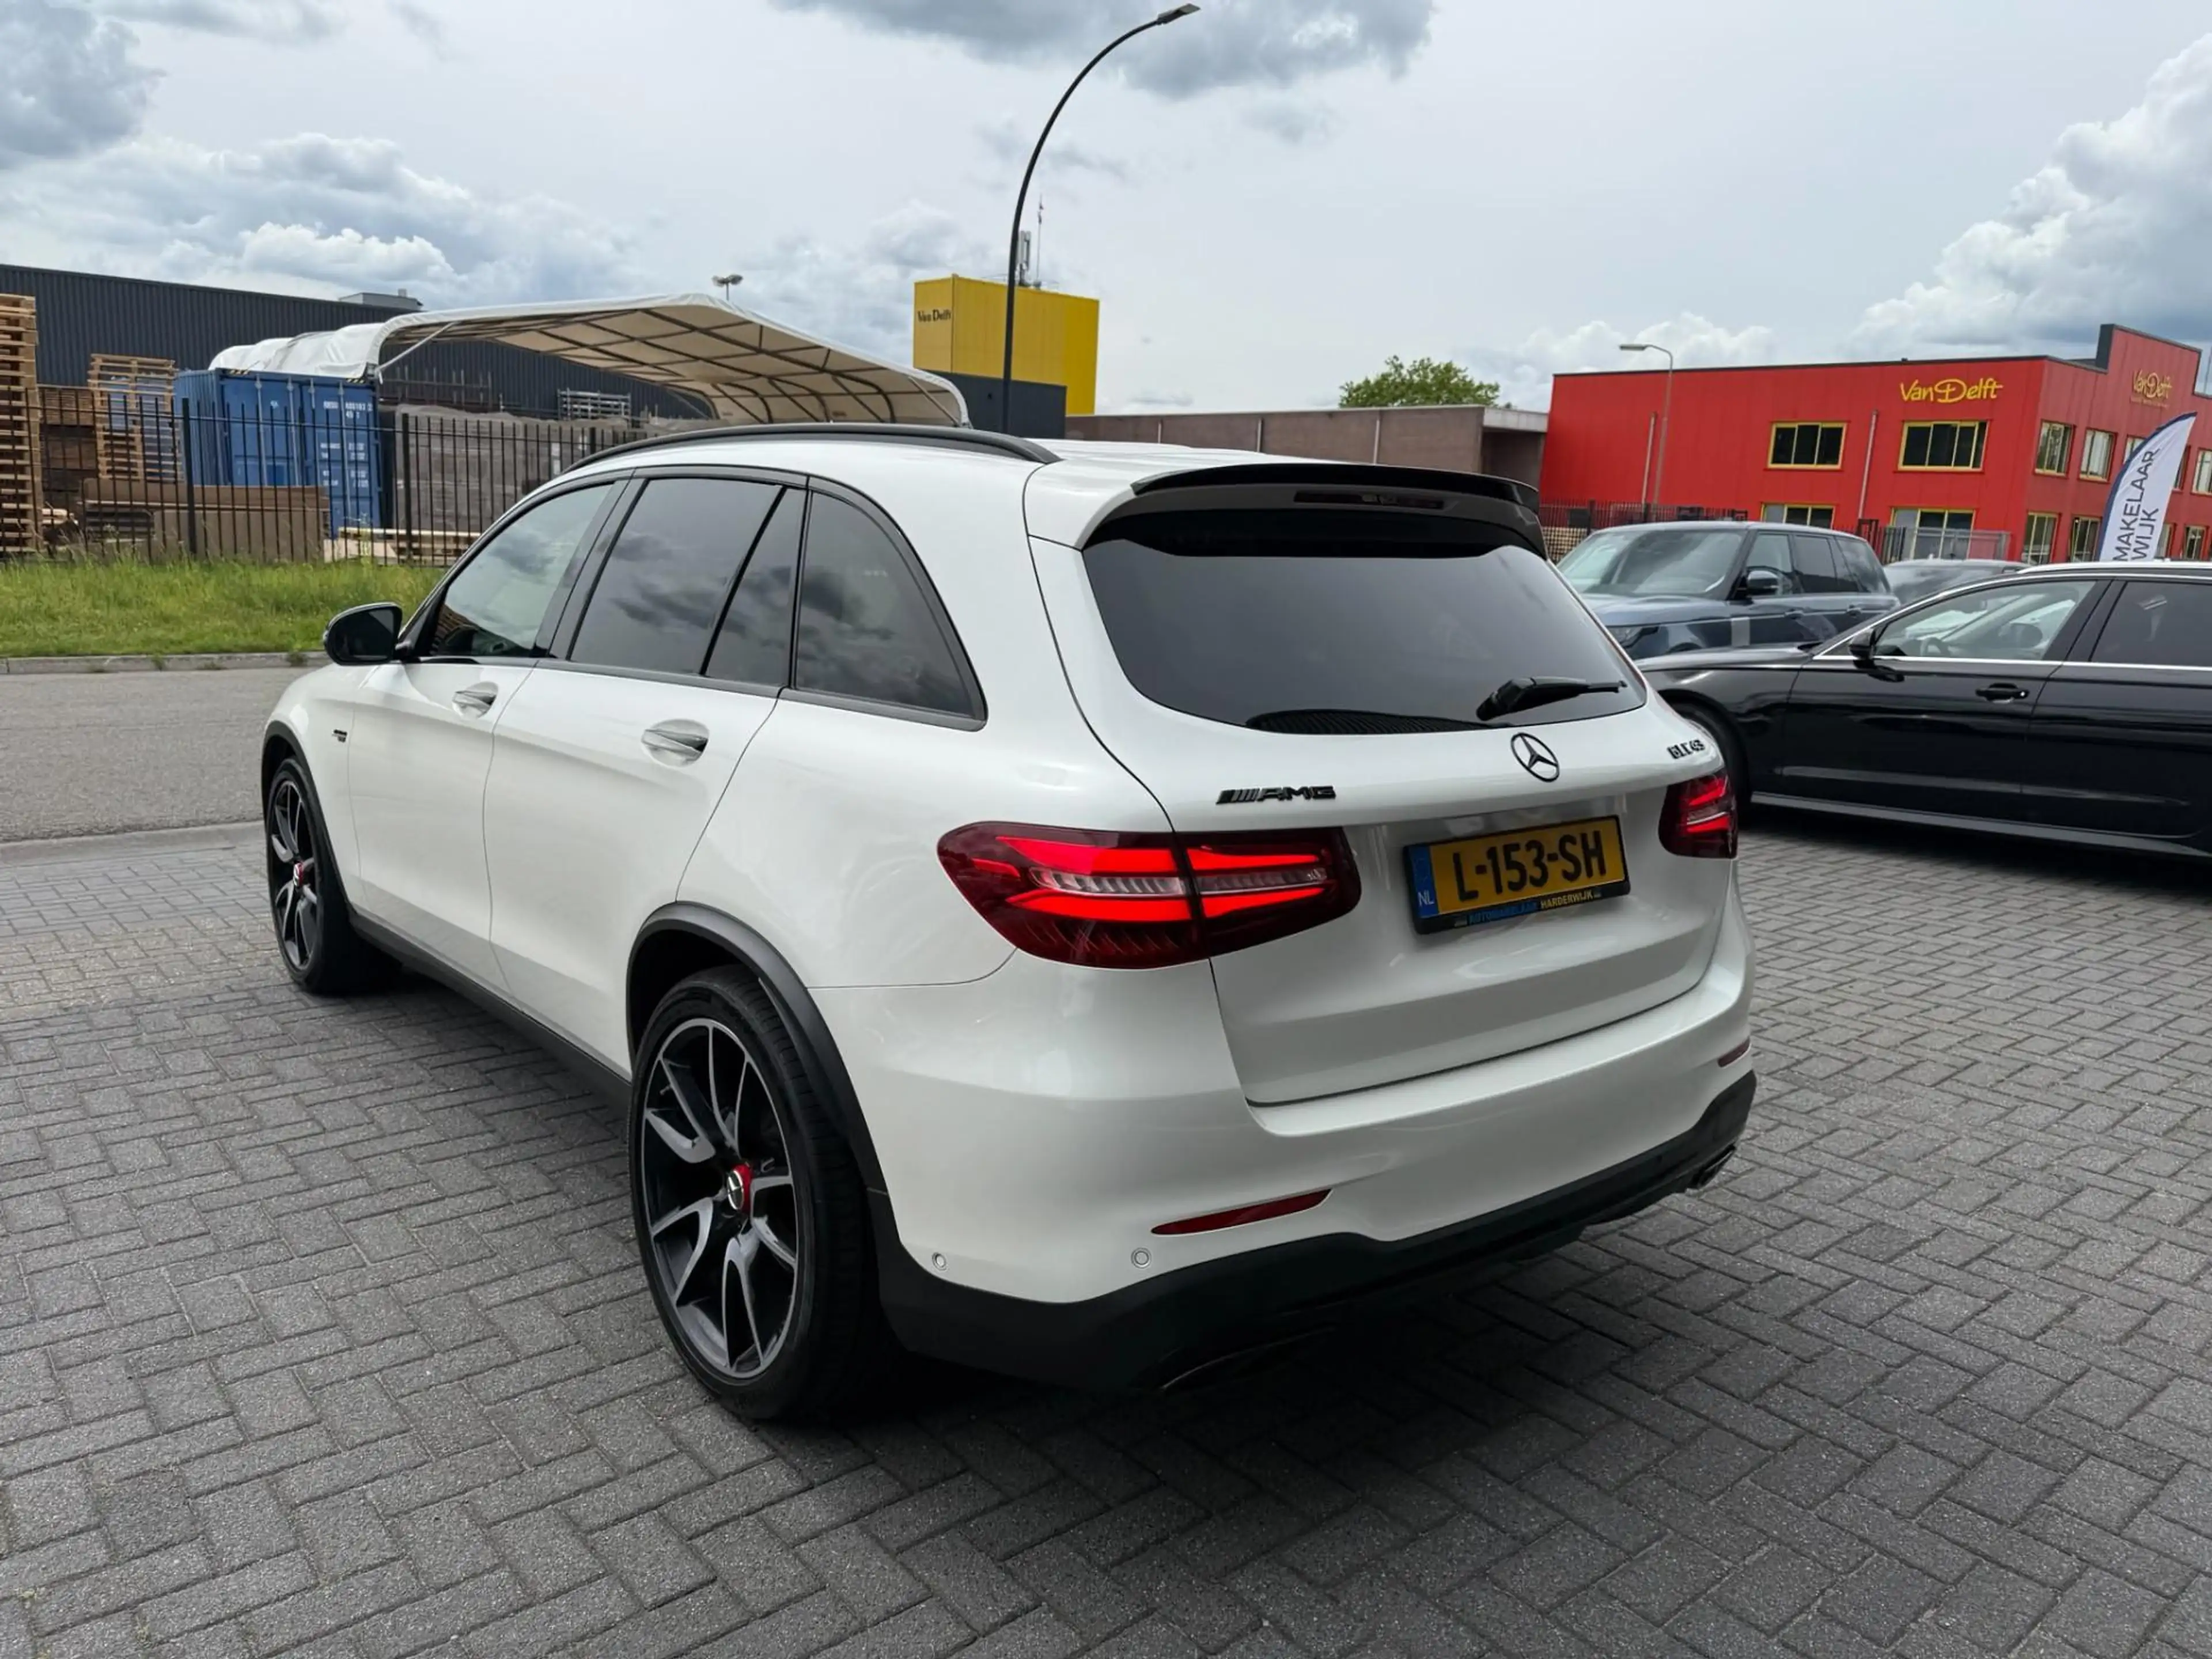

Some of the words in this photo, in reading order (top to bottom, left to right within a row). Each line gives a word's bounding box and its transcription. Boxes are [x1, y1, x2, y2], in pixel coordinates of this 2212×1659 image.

[1256, 785, 1336, 802] AMG
[1452, 830, 1607, 902] L-153-SH
[1418, 891, 1435, 907] NL
[1540, 891, 1594, 910] HARDERWIJK
